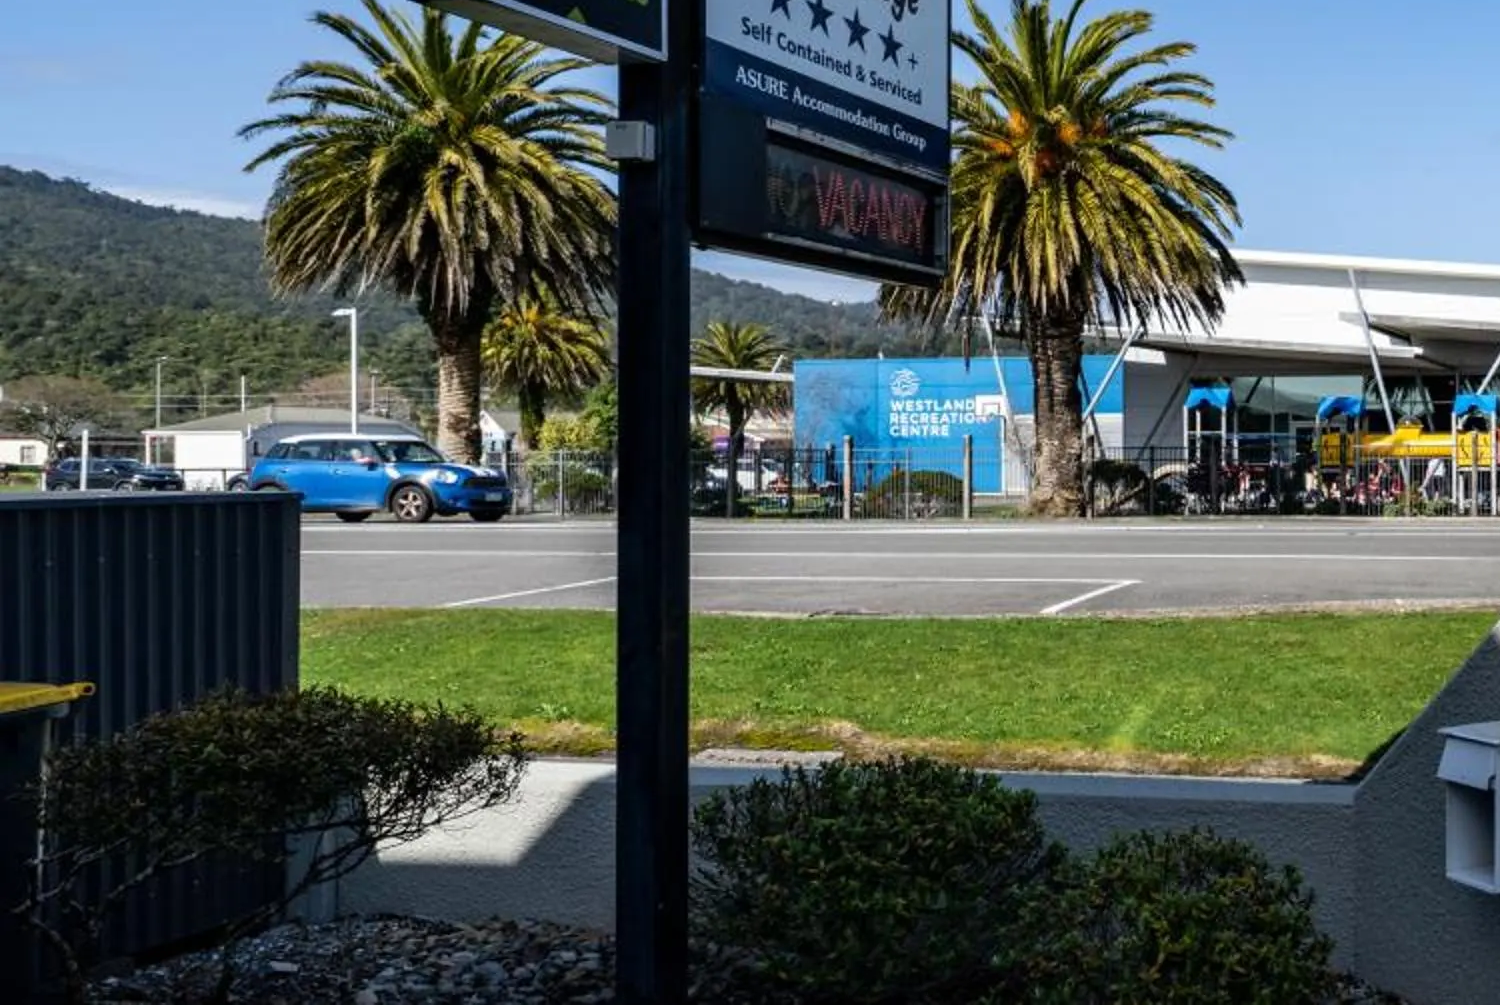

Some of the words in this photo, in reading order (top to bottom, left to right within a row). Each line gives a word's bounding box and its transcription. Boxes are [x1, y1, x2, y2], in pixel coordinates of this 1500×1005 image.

[740, 15, 773, 46] Self
[776, 31, 852, 77] Contained
[855, 64, 866, 83] &
[869, 70, 923, 105] Serviced
[735, 64, 790, 100] ASURE
[792, 85, 891, 137] Accommodation
[892, 124, 927, 153] Group
[889, 425, 949, 437] CENTRE
[890, 399, 975, 412] WESTLAND
